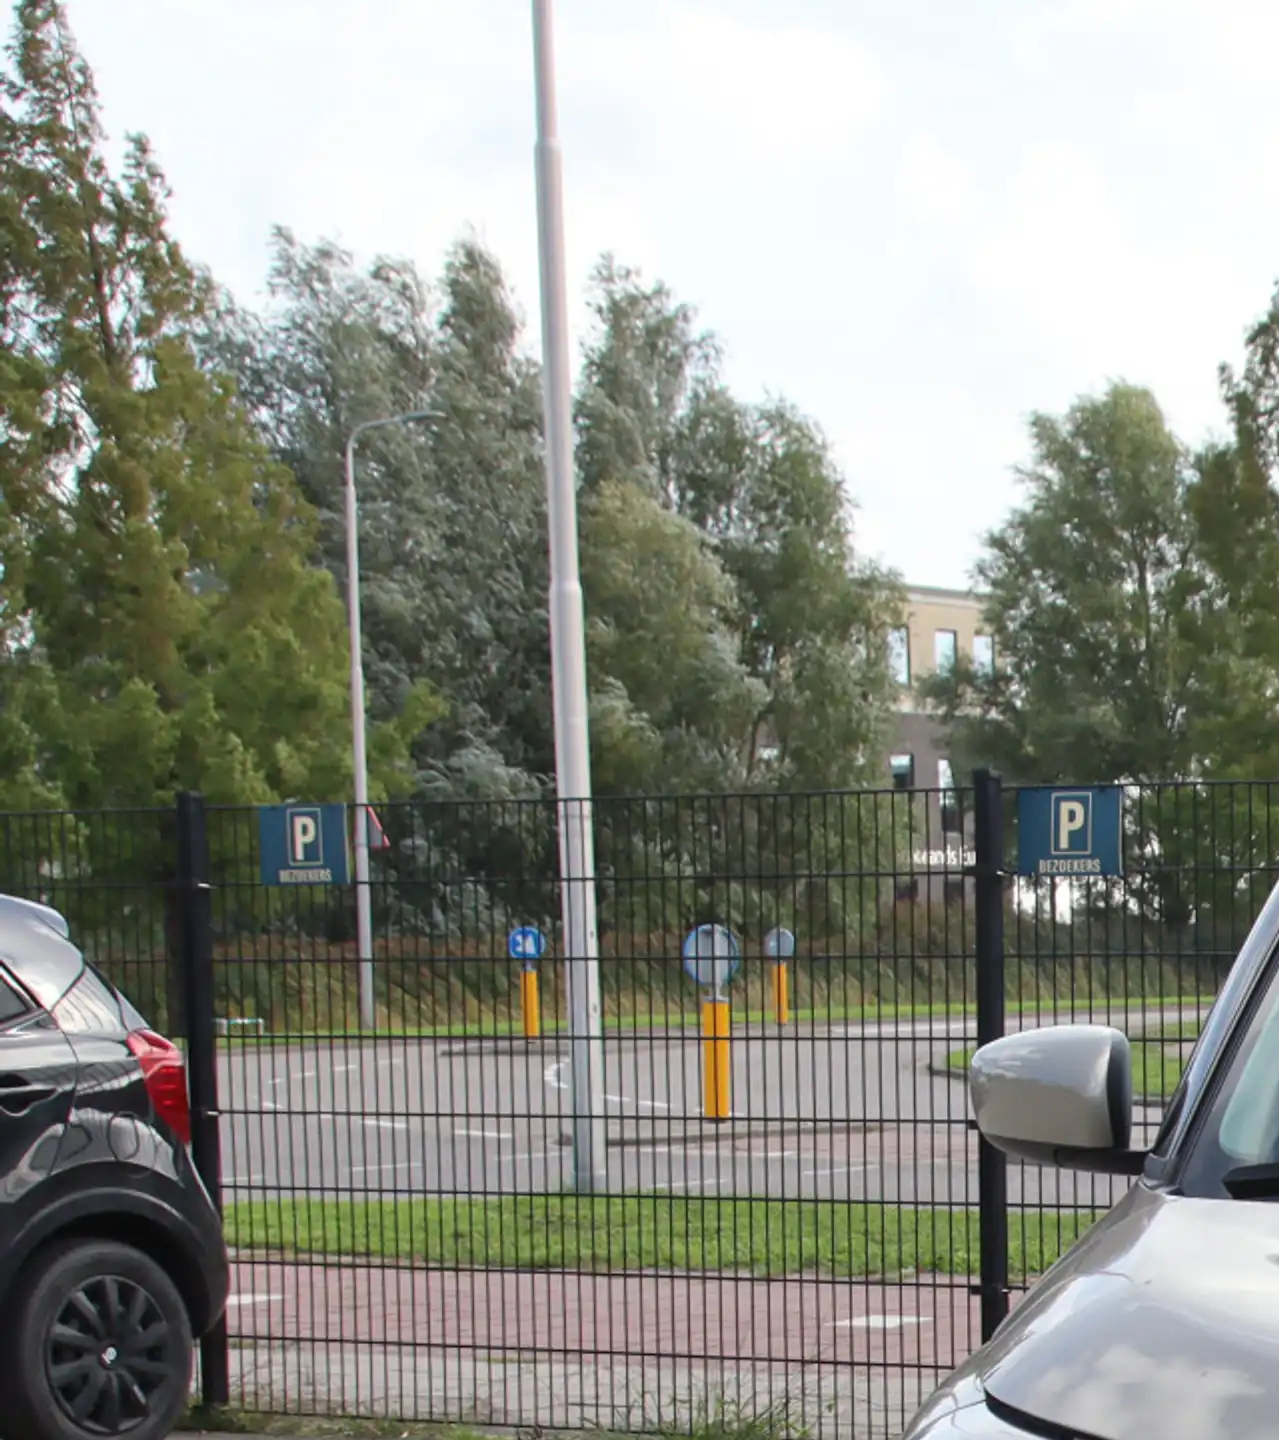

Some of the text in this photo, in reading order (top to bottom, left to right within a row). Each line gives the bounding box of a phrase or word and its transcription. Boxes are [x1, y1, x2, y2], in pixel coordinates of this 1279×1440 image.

[294, 816, 316, 860] P
[1059, 800, 1084, 850] P
[1038, 858, 1101, 874] BEZOEKERS
